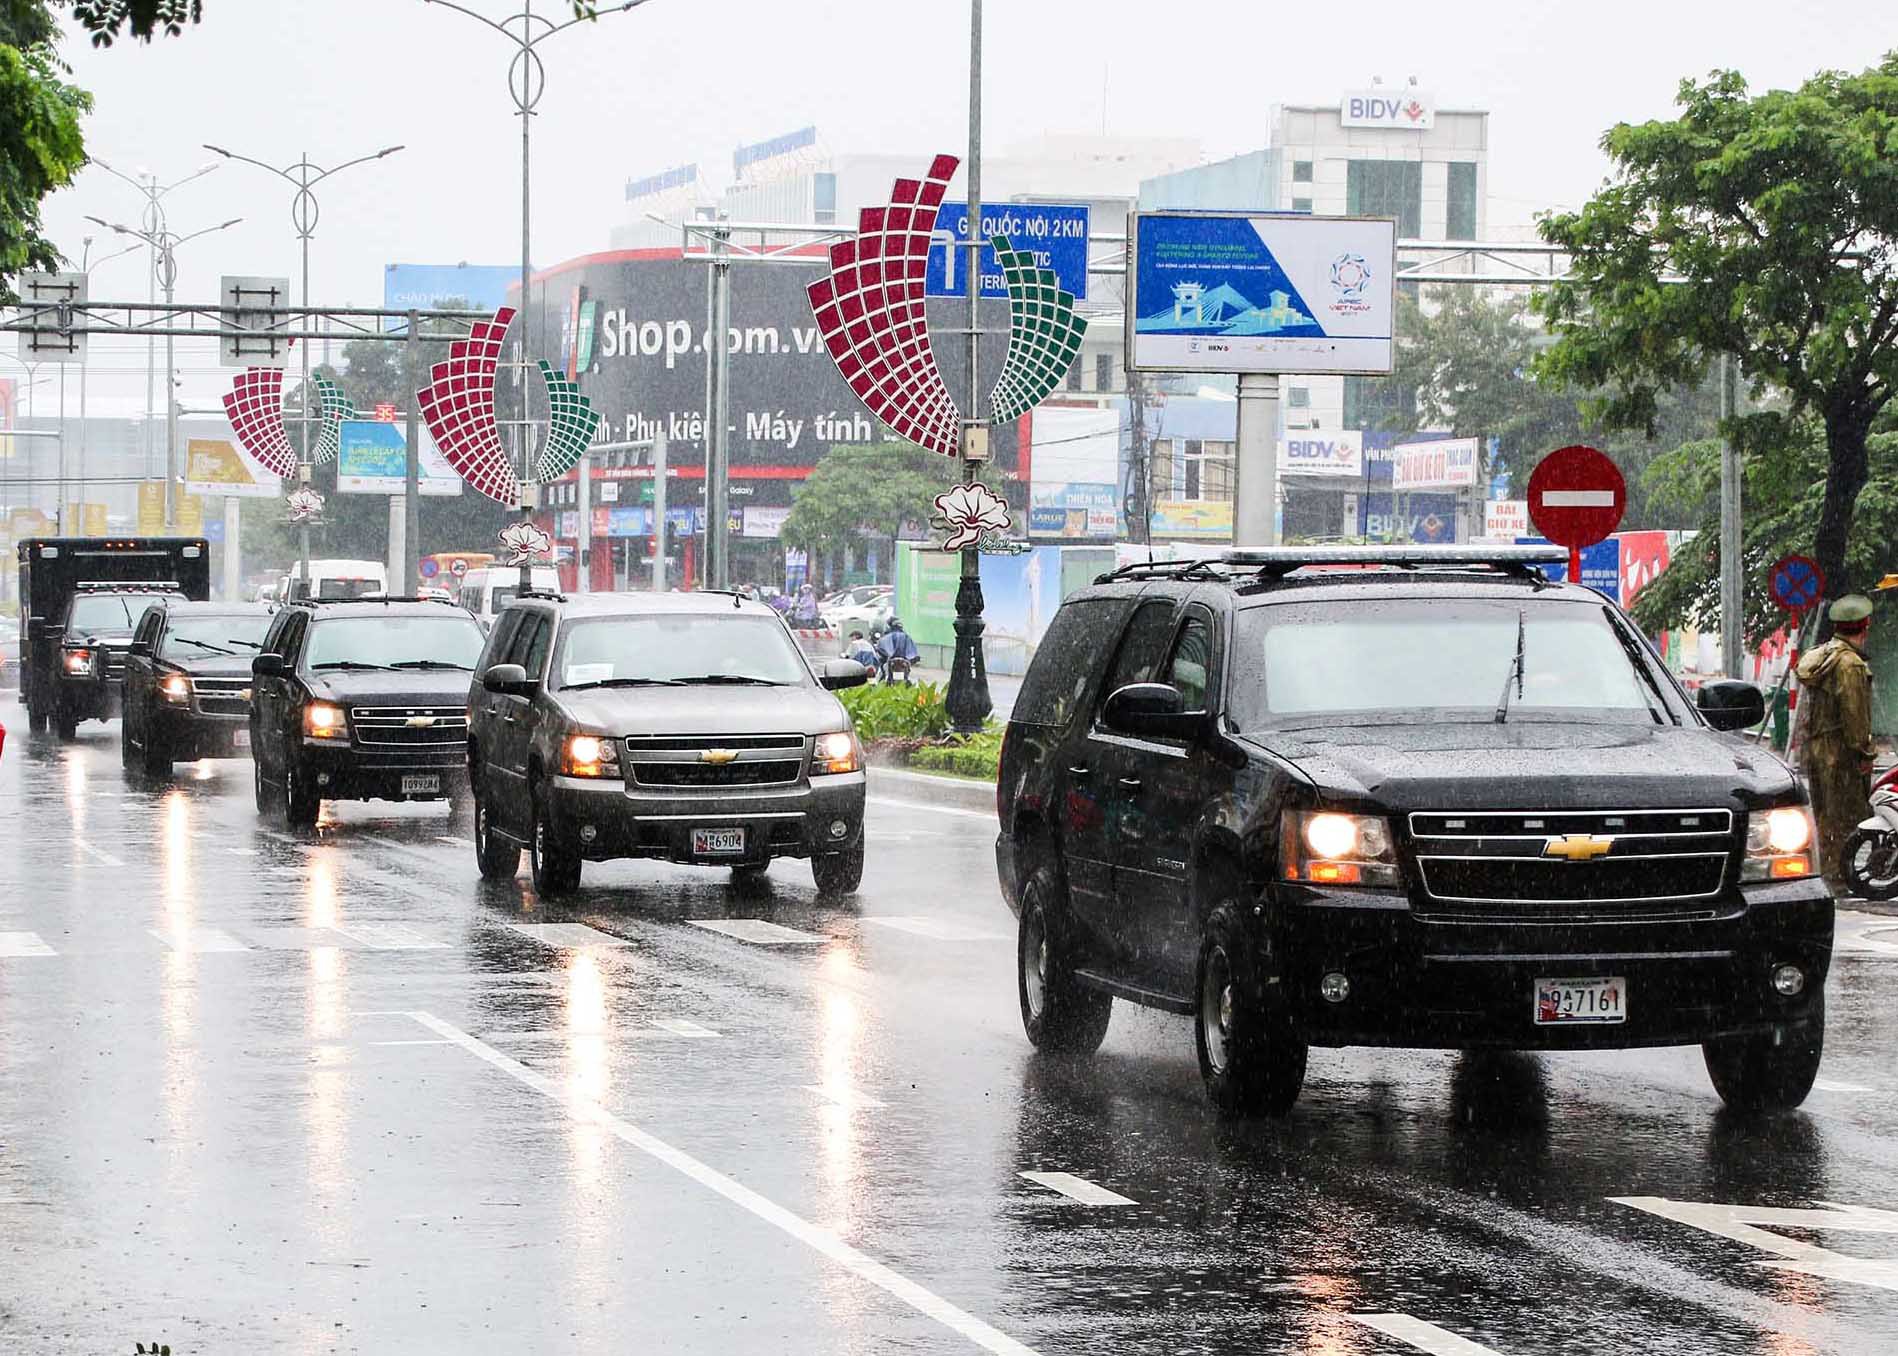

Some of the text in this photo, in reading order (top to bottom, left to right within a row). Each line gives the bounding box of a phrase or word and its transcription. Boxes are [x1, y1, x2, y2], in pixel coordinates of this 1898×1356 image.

[1350, 98, 1401, 119] BIDV
[1025, 215, 1049, 240] NỘI
[746, 410, 804, 449] Máy
[814, 411, 871, 440] tính
[1288, 441, 1333, 458] BIDV
[729, 486, 754, 495] Galaxy
